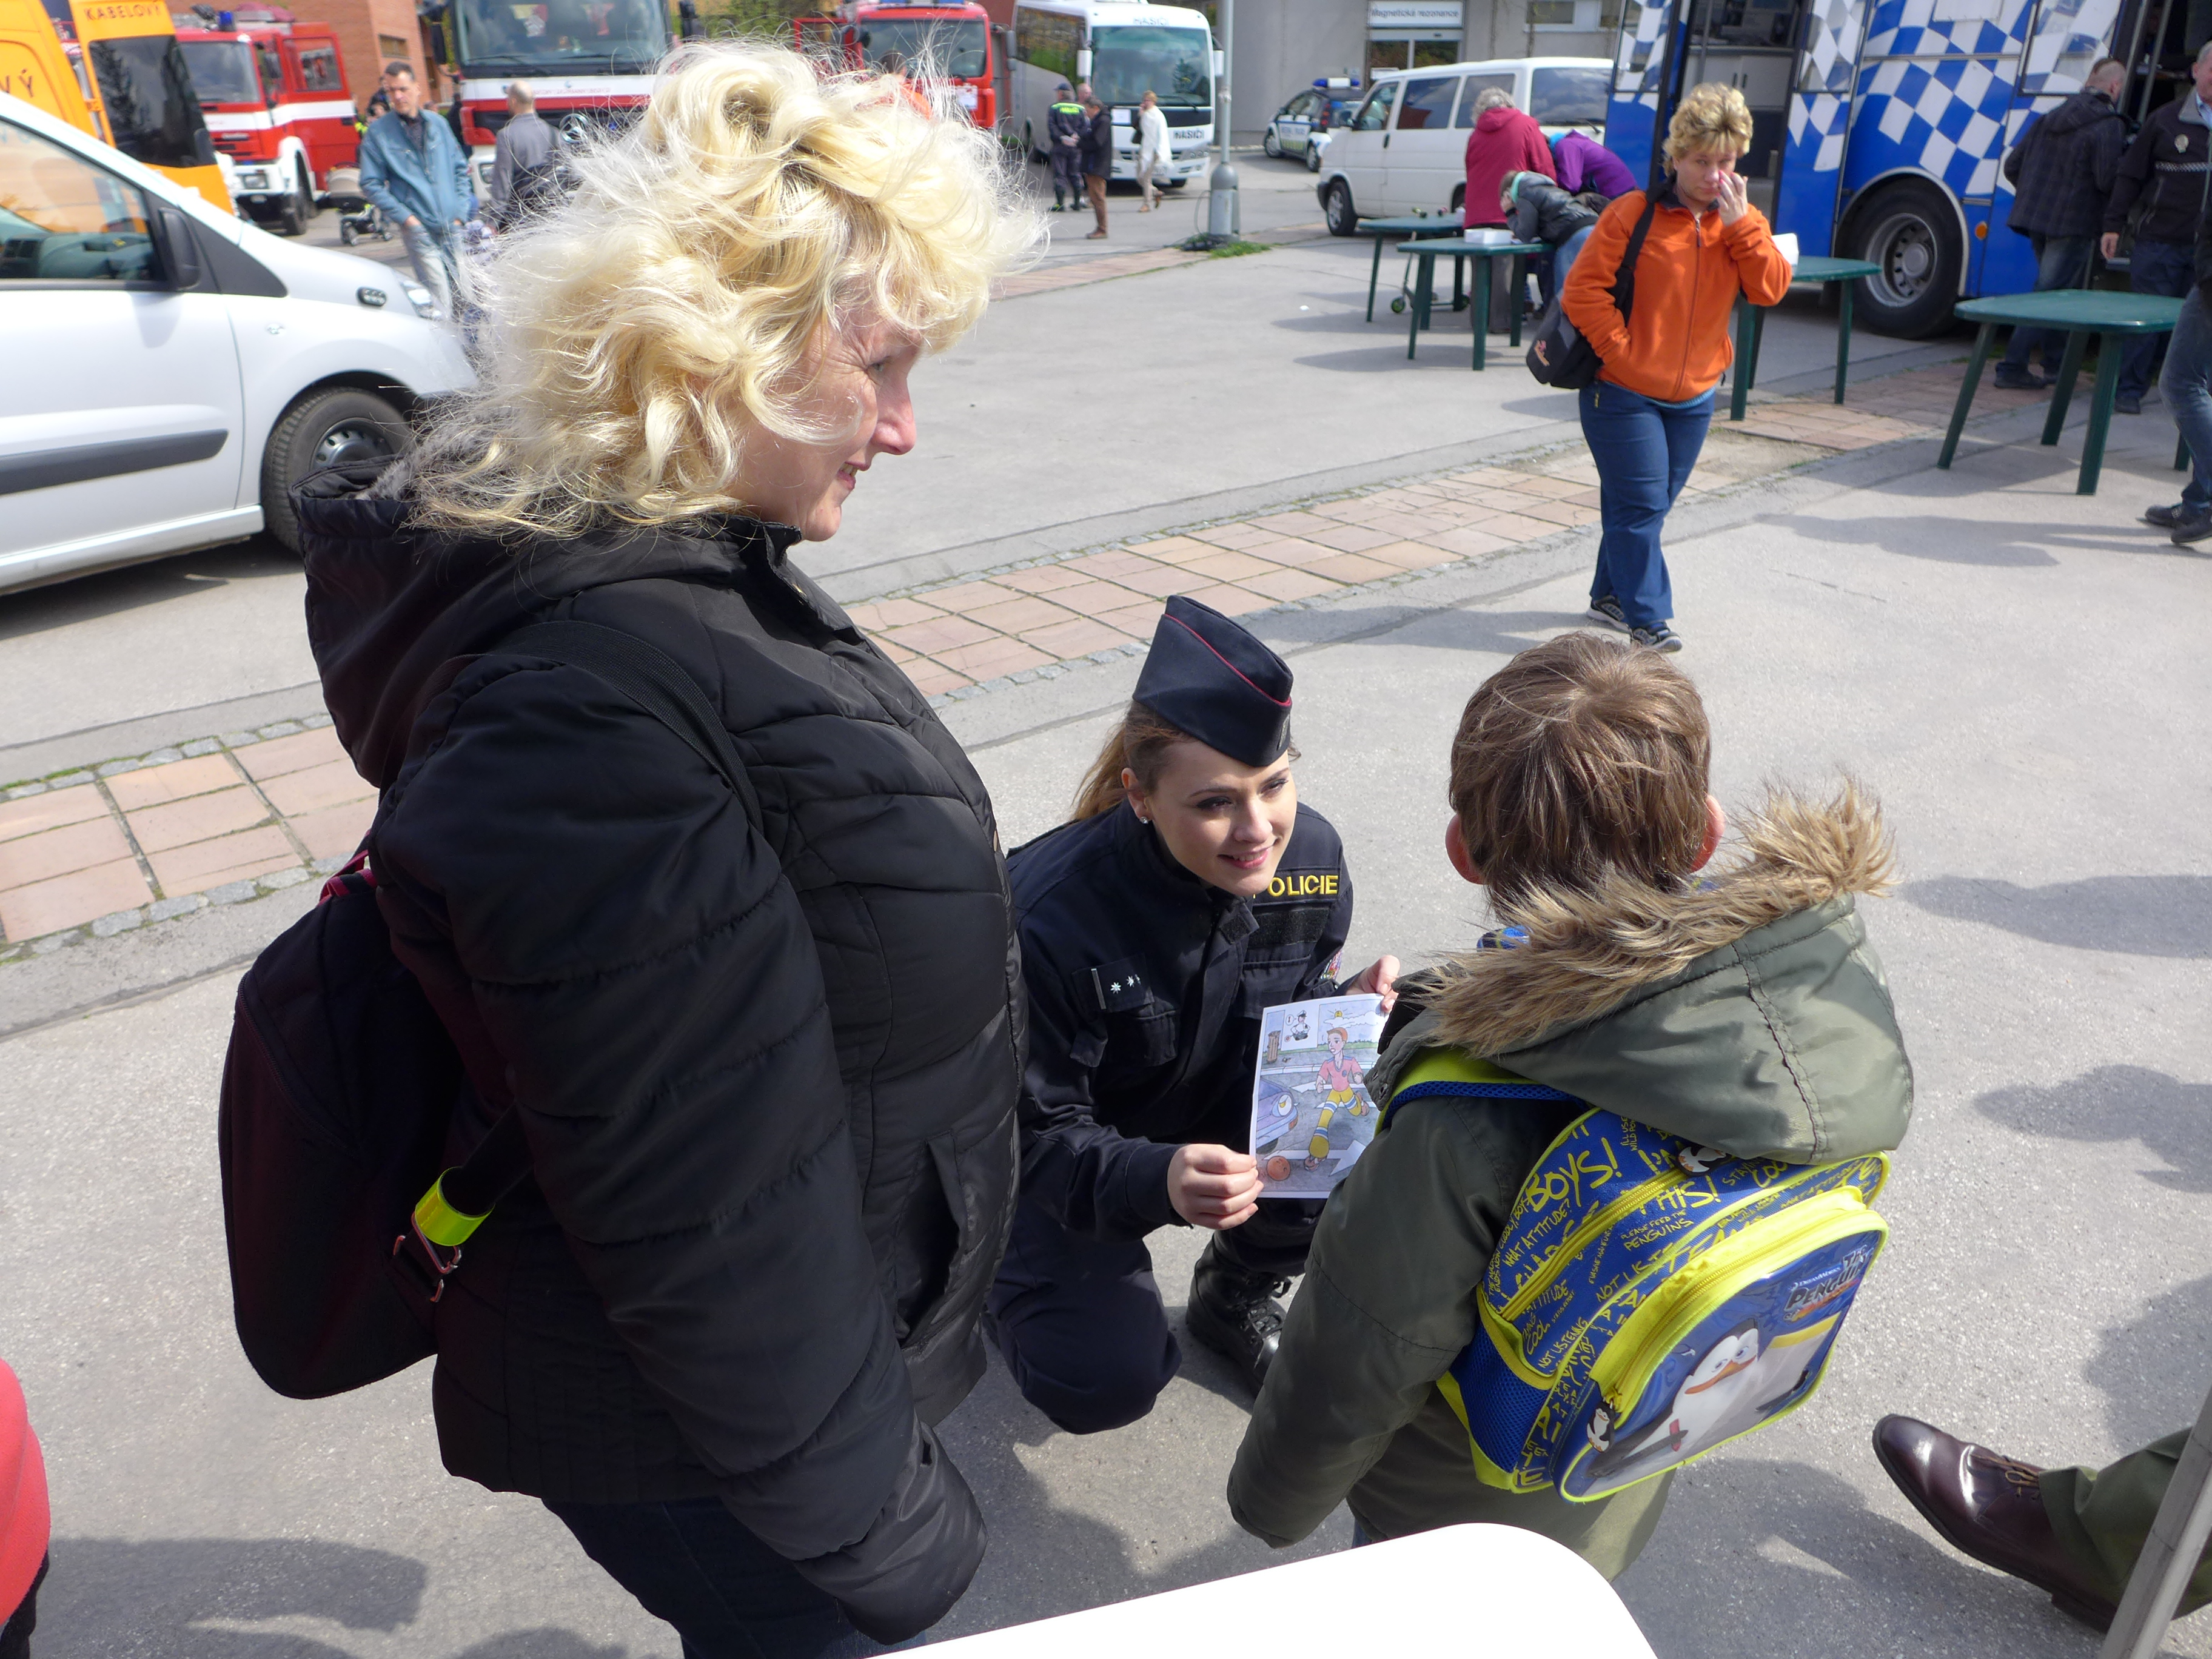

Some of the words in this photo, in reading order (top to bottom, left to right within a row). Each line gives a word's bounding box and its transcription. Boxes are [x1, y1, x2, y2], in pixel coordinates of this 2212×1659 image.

[1254, 874, 1339, 899] OLICIE
[1524, 1137, 1623, 1212] BOYS!
[1624, 1218, 1694, 1251] PENGUINS
[1502, 1241, 1525, 1267] WHAT
[1595, 1274, 1620, 1303] NOT
[1538, 1350, 1557, 1369] NOT
